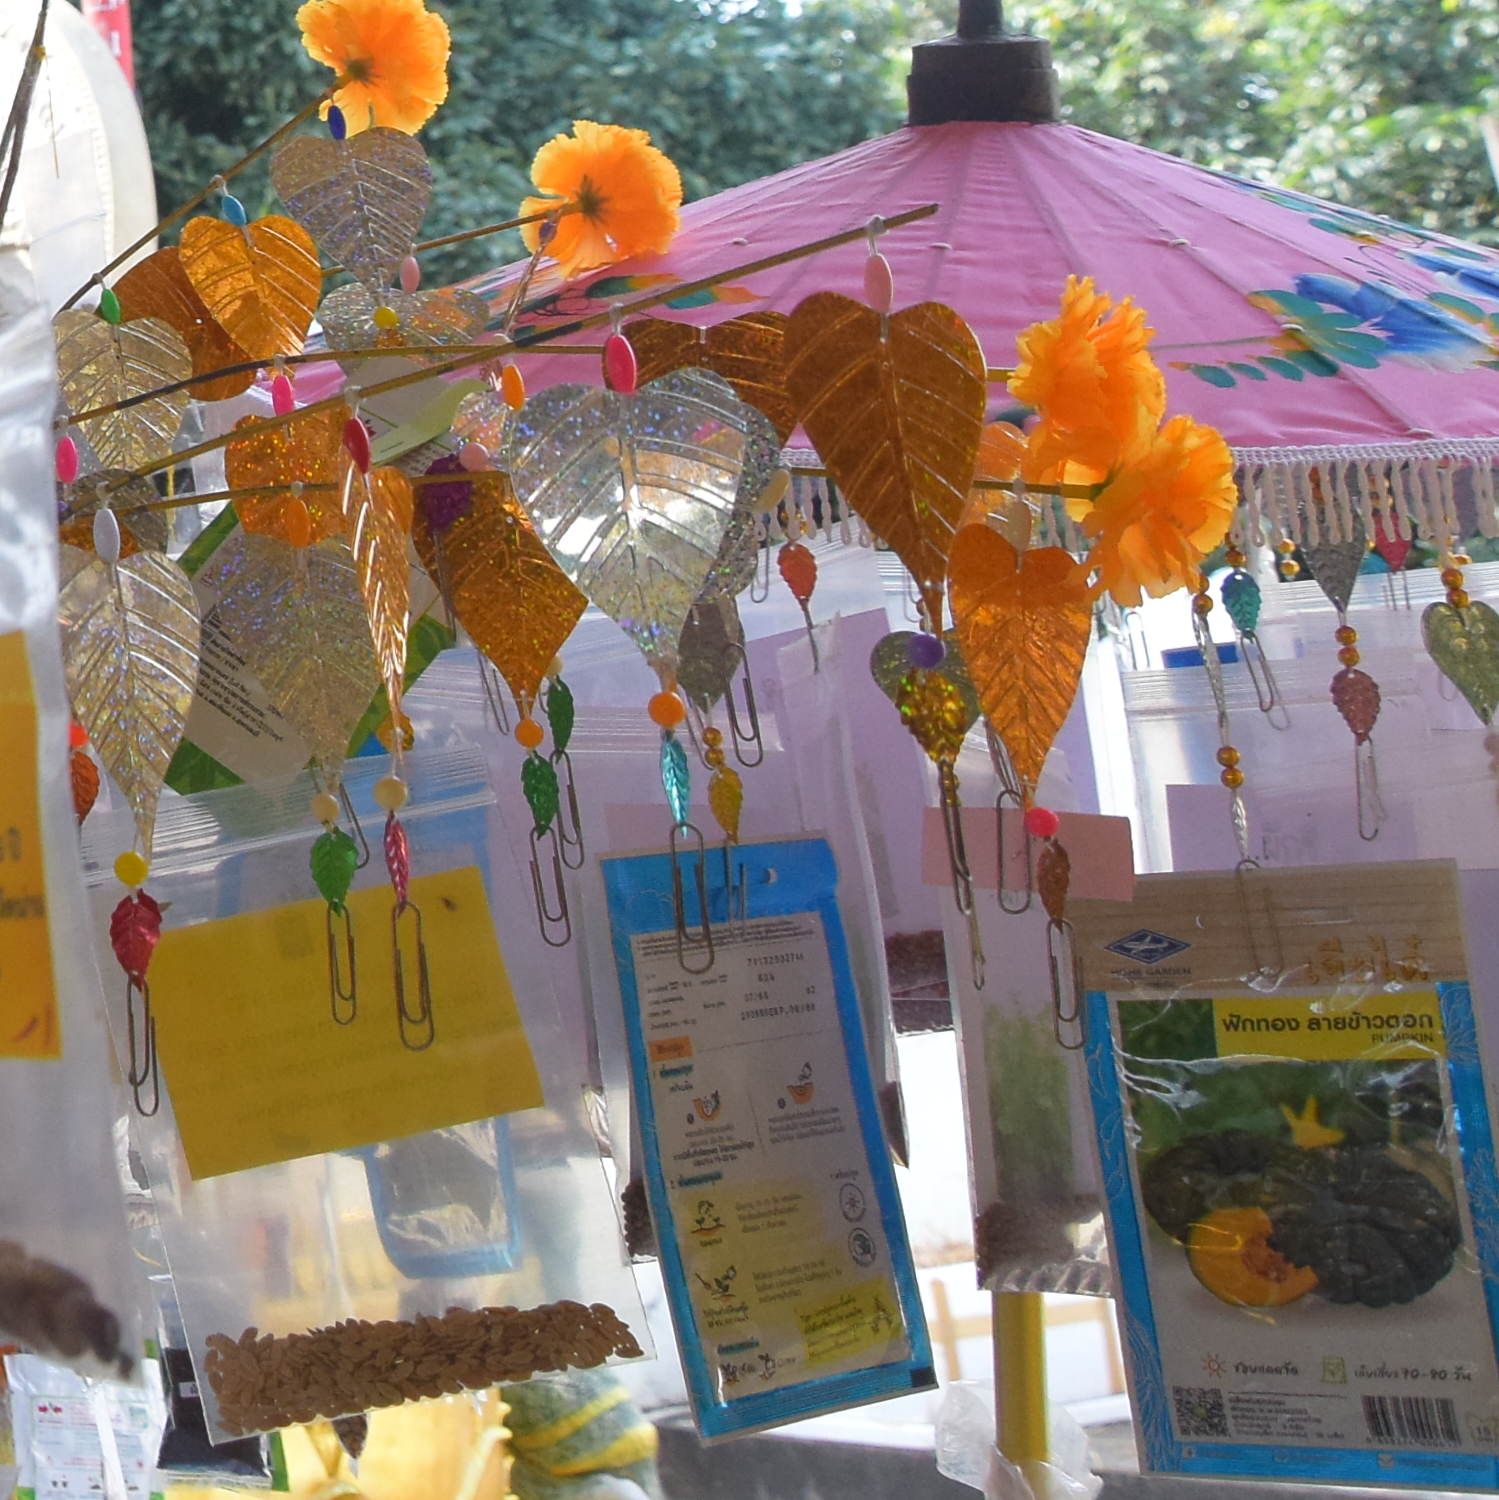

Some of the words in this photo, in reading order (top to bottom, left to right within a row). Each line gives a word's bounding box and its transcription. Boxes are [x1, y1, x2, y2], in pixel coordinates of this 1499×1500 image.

[1111, 968, 1143, 978] HOME
[1146, 966, 1191, 977] GARDEN
[1222, 1014, 1301, 1034] ฟักทอง
[1307, 1011, 1433, 1033] ลายข้าวตอก
[1371, 1033, 1434, 1044] PUMPKIN
[1401, 1367, 1448, 1382] 70-80
